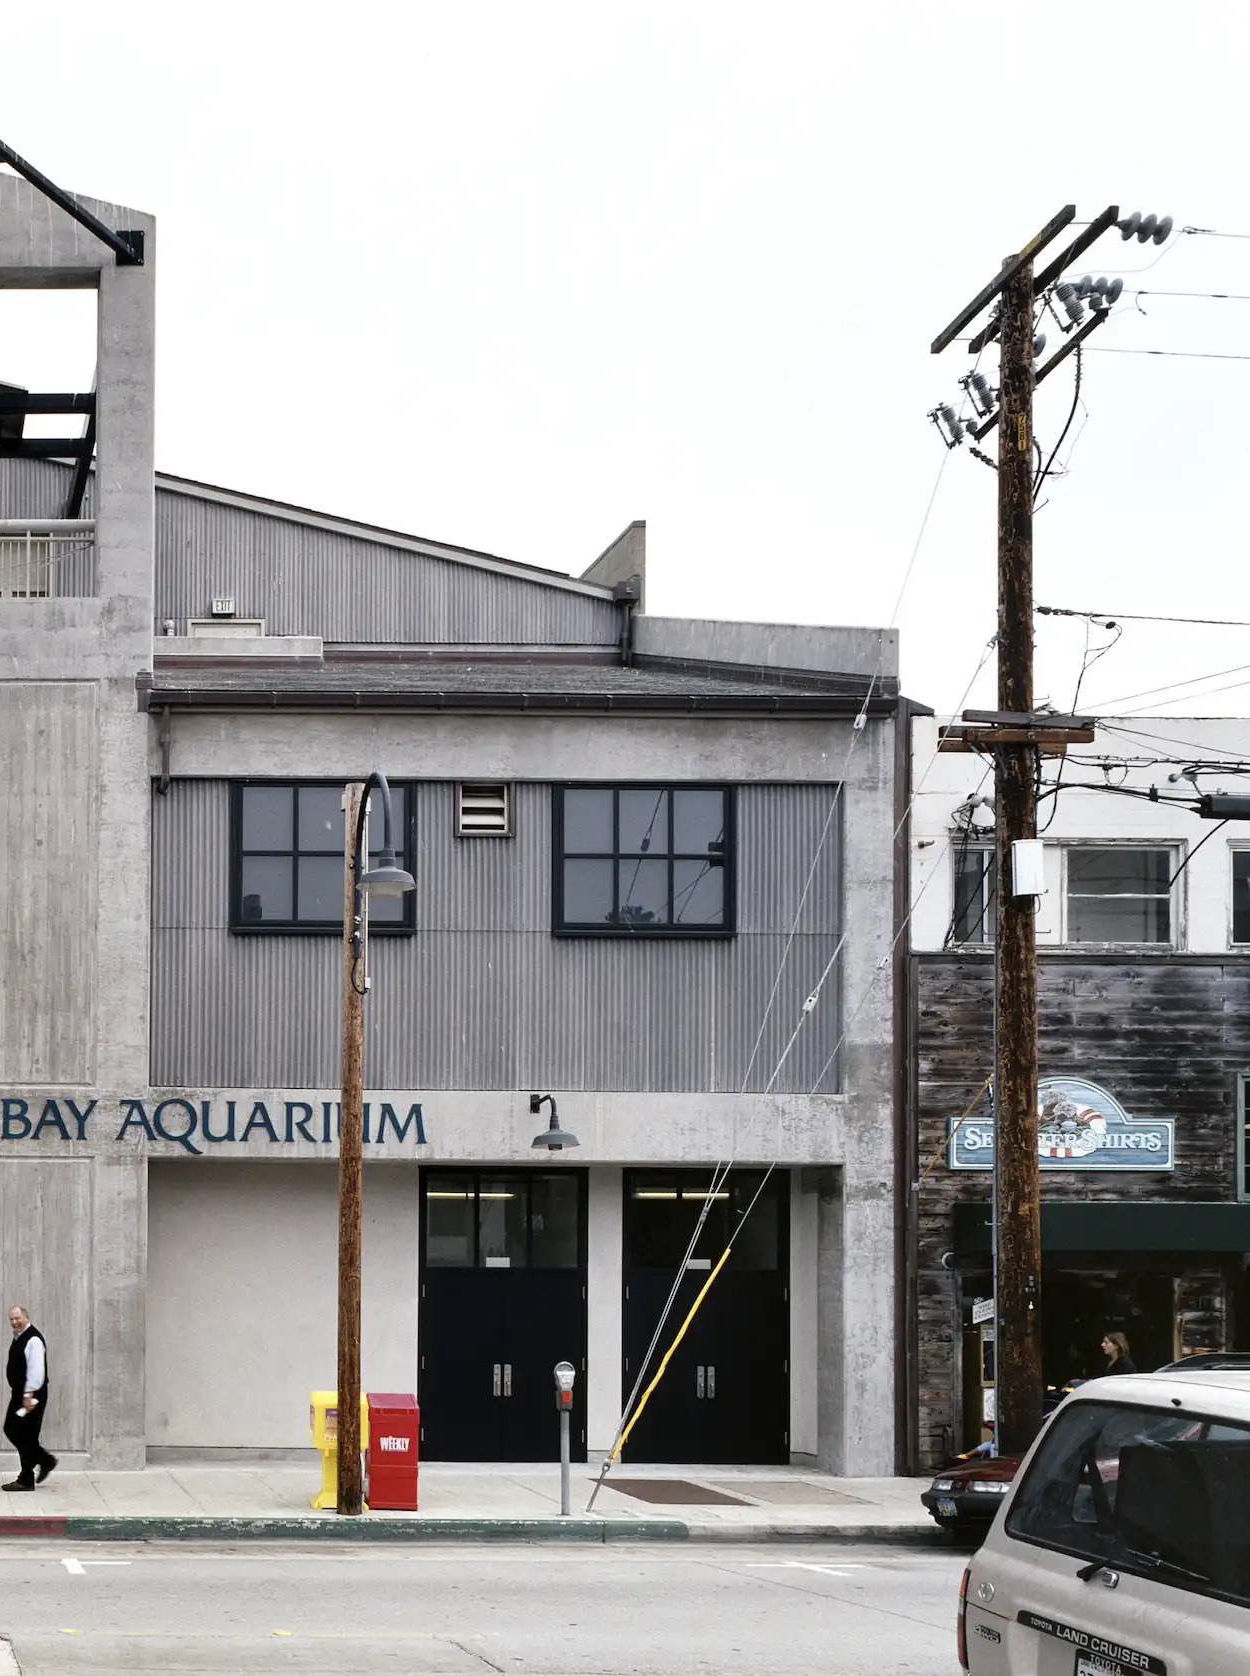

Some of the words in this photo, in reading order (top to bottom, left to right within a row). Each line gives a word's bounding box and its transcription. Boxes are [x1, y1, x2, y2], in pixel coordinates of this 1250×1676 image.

[1018, 413, 1026, 450] 7581
[215, 600, 231, 611] EXIT
[0, 1099, 98, 1140] BAY
[380, 1436, 410, 1452] WEEKLY
[974, 1625, 1000, 1643] 4WD
[1030, 1617, 1052, 1632] TOYOTA
[1056, 1625, 1088, 1646] LAND
[1090, 1638, 1149, 1669] CRUISER
[1090, 1654, 1122, 1674] TOYOTA
